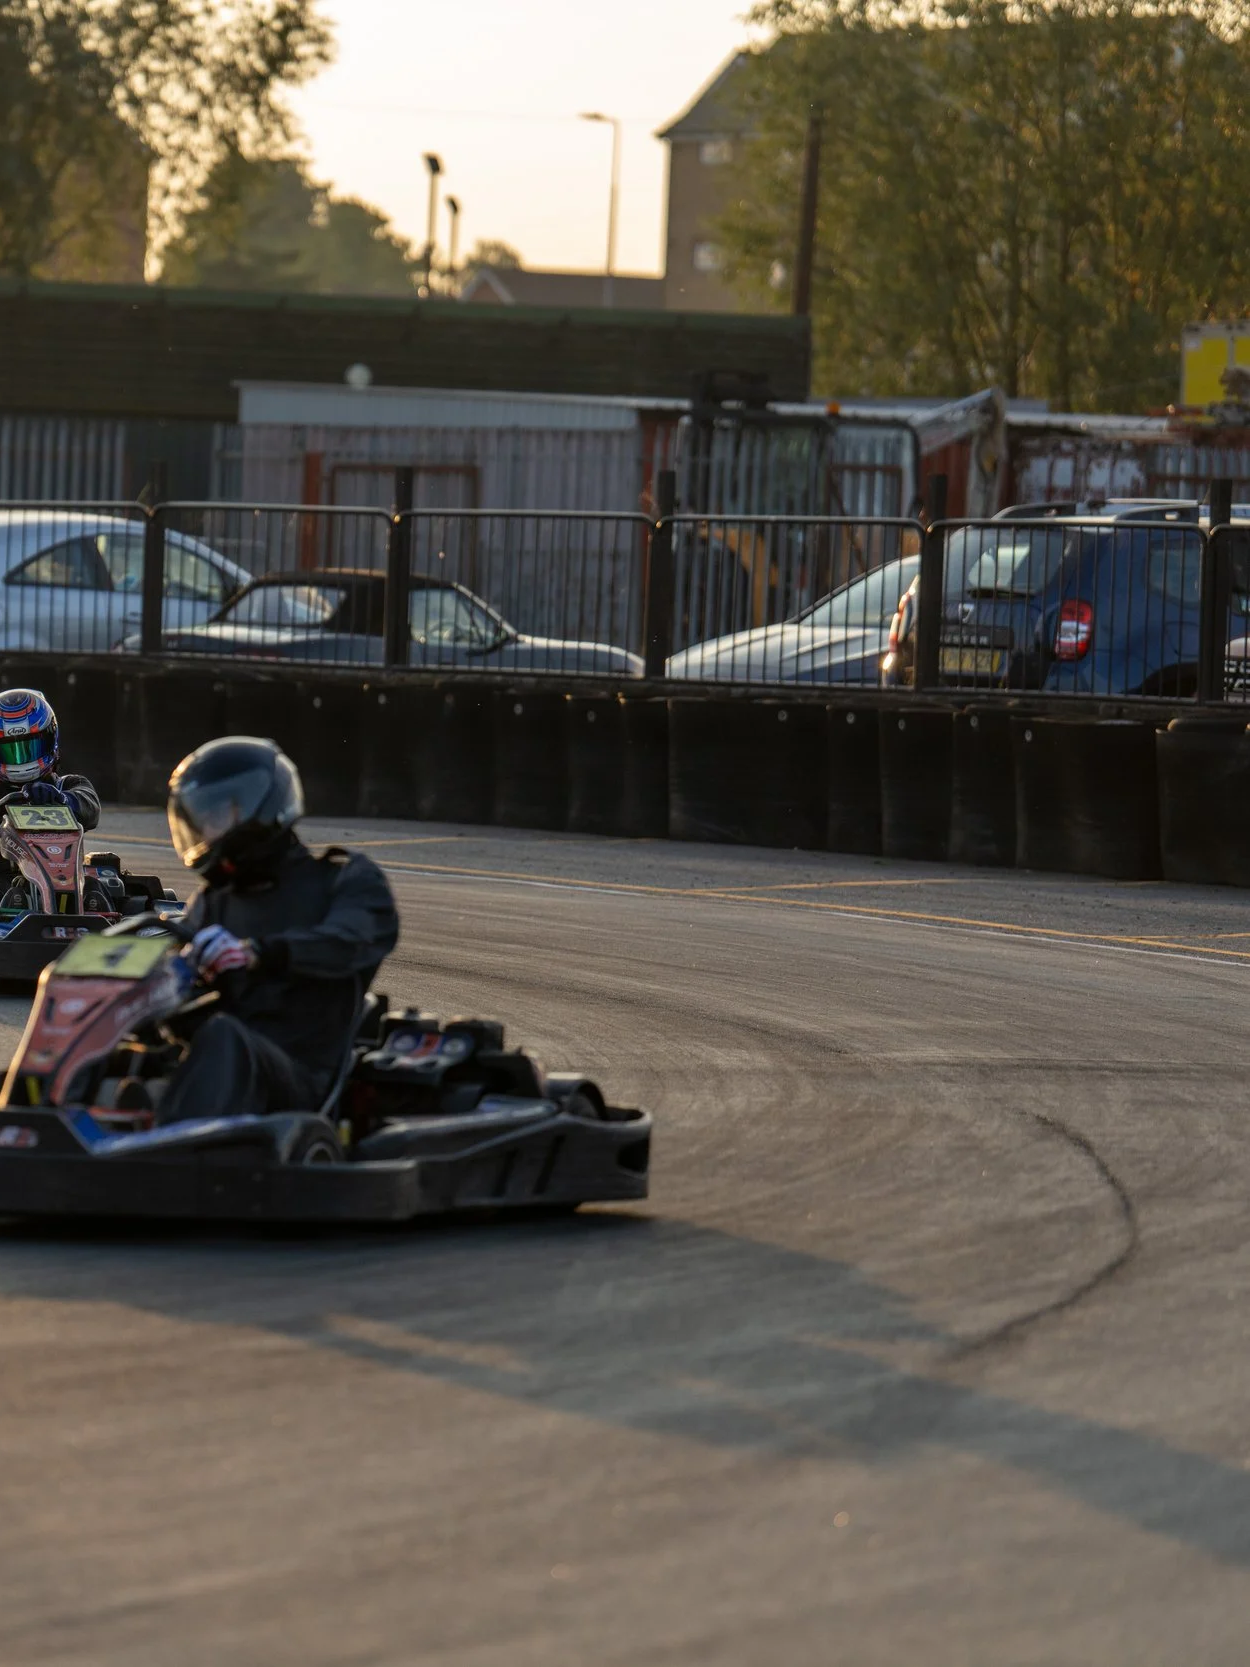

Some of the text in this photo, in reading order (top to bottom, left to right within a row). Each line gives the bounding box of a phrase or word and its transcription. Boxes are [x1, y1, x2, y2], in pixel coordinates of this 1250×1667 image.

[9, 727, 25, 735] Arai
[21, 809, 68, 826] 23
[5, 837, 28, 859] HOUSE
